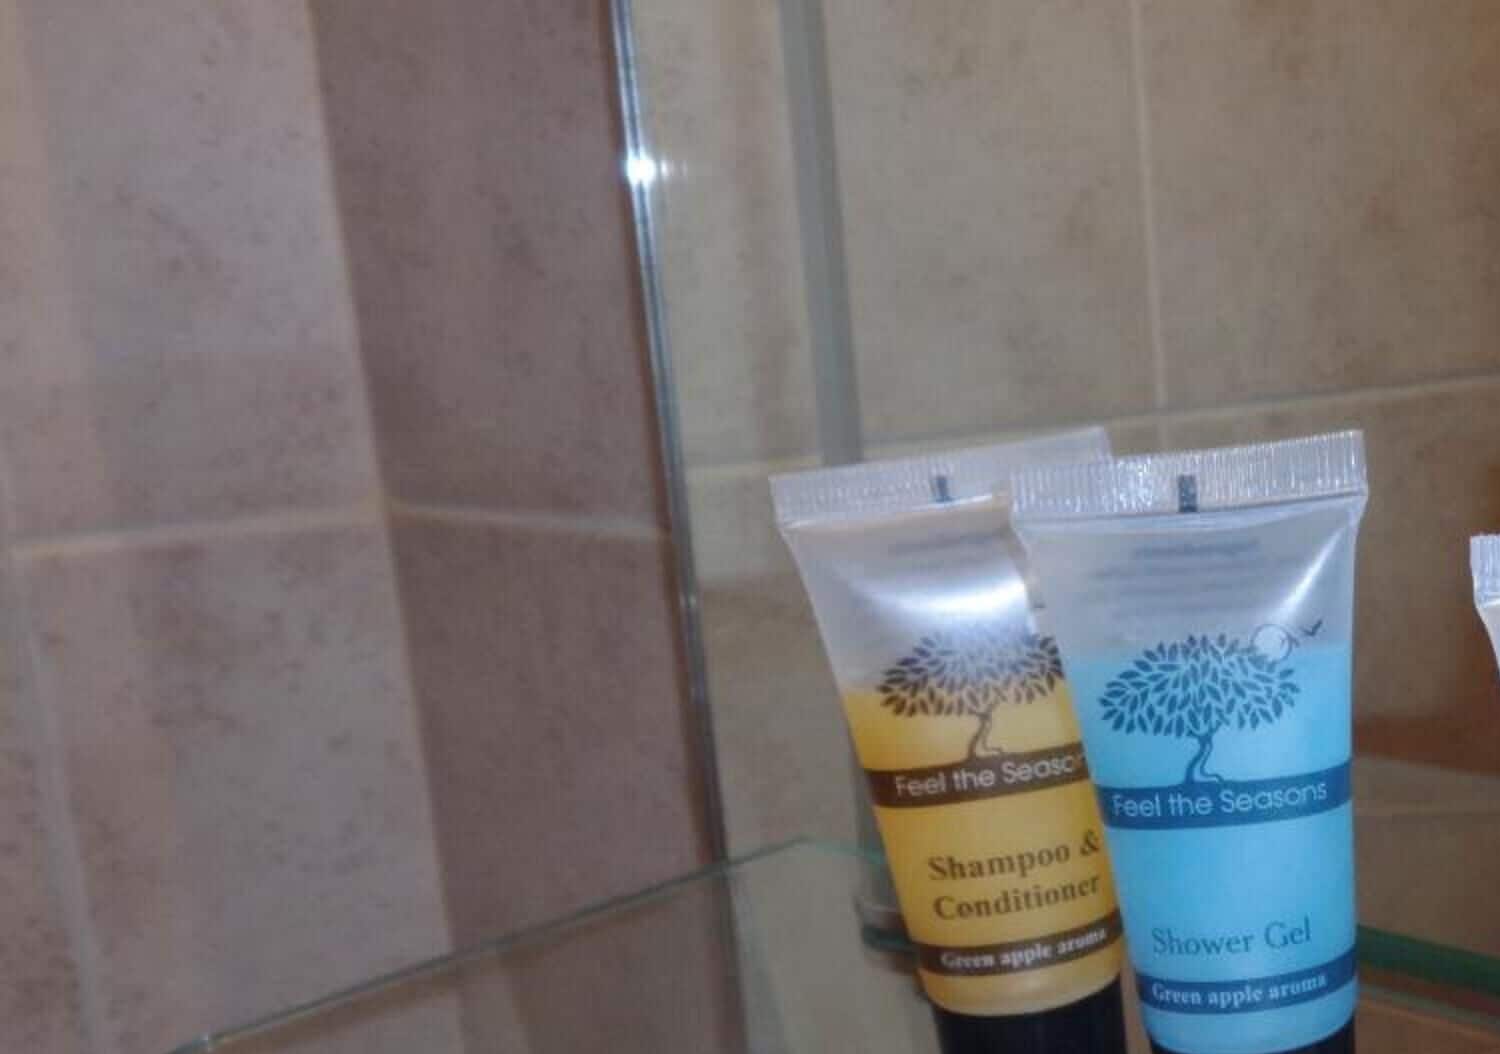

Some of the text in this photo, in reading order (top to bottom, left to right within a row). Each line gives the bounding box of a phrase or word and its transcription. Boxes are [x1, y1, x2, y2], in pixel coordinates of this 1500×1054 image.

[895, 755, 1078, 797] Feel the Seaso
[1112, 782, 1328, 817] Feel the Seasons
[928, 828, 1100, 881] Shampoo &
[933, 874, 1100, 921] Conditioner
[941, 927, 1107, 969] Green apple aroma
[1152, 913, 1312, 956] Shower Gel
[1152, 972, 1328, 1009] Green apple aroma
